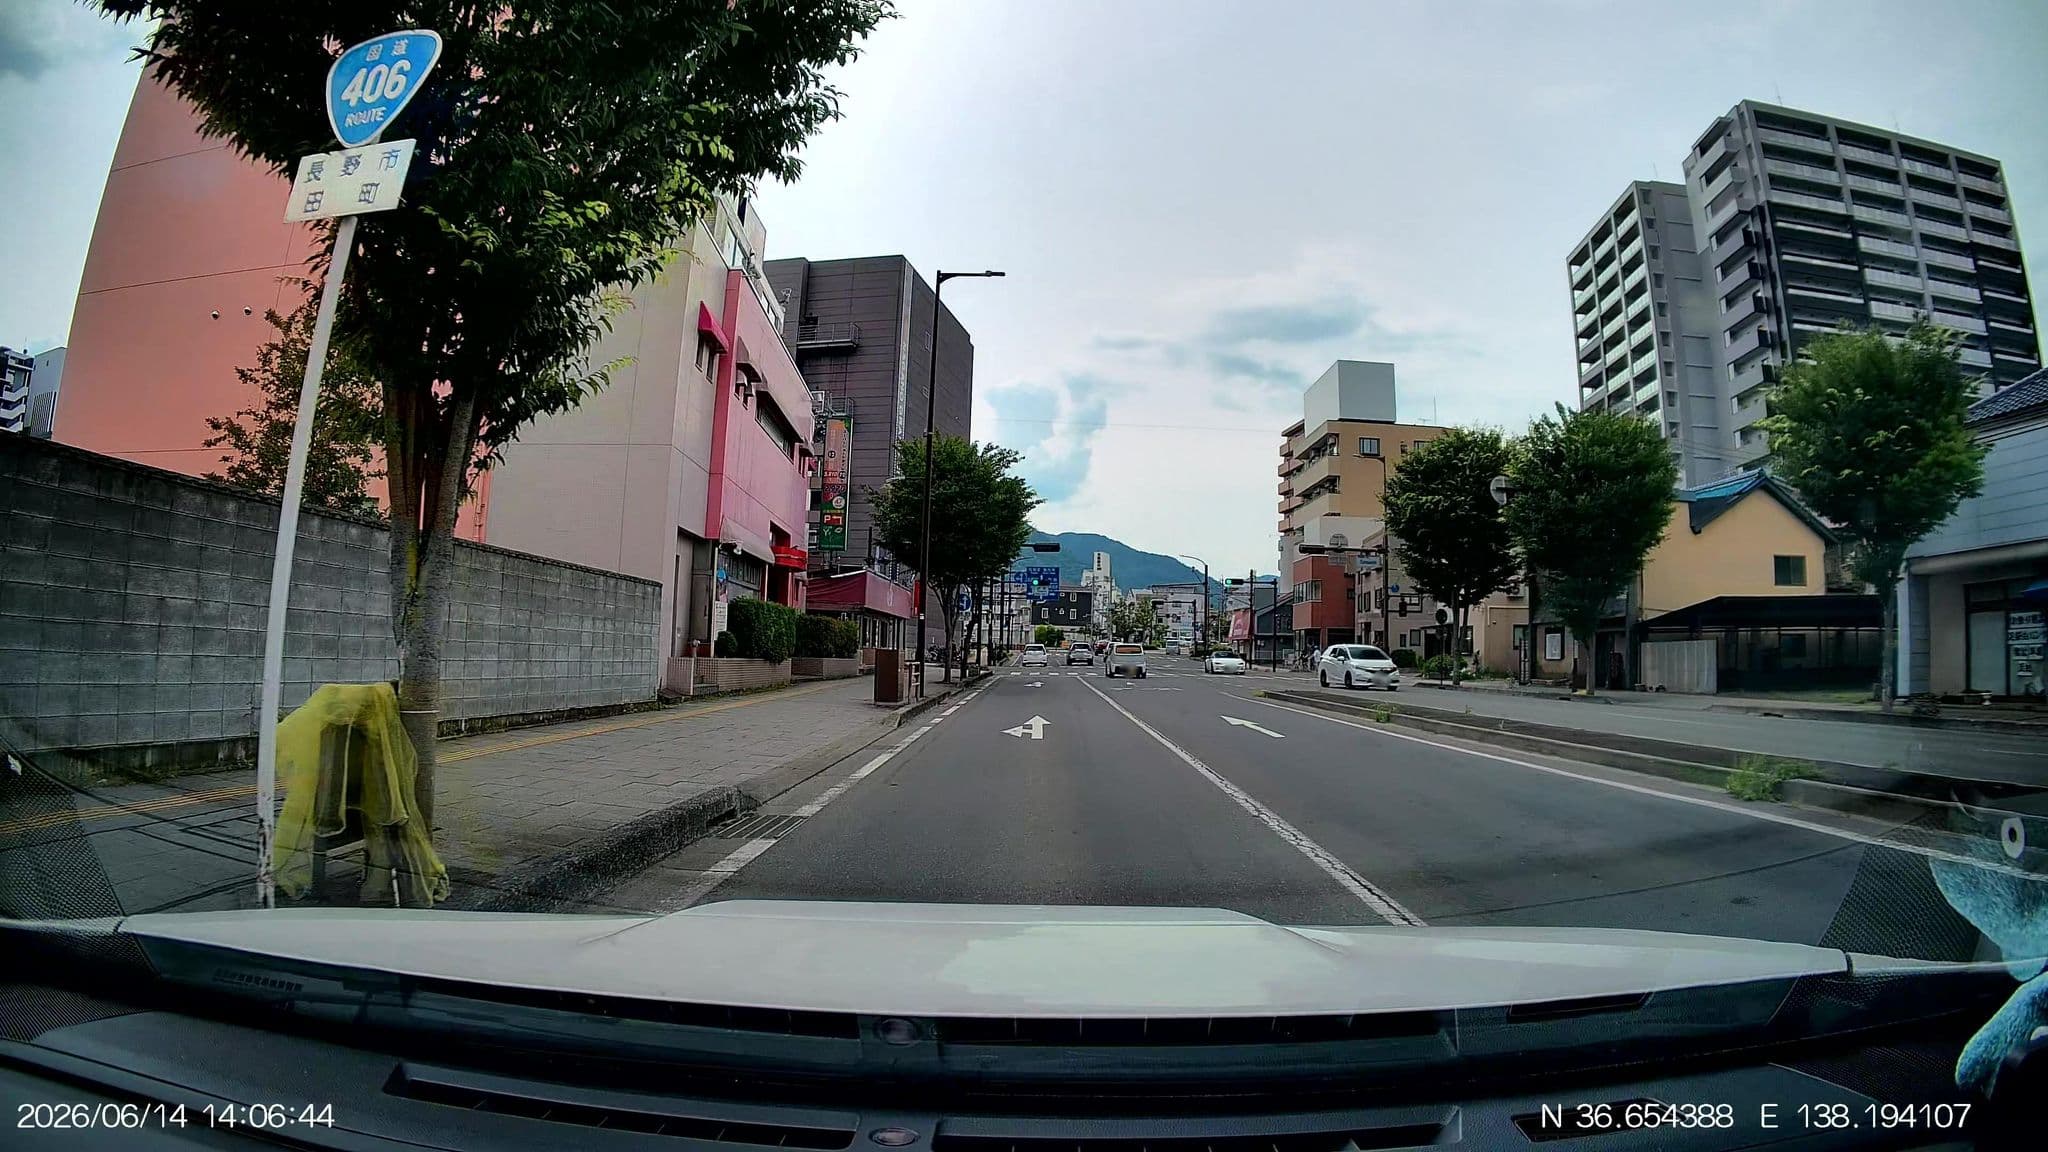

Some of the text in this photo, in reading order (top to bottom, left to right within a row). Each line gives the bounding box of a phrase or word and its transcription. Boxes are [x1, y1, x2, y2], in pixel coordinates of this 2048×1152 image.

[366, 39, 408, 61] 国道
[341, 59, 411, 107] 406
[345, 107, 386, 127] ROUTE
[305, 149, 402, 183] 長野市
[303, 182, 380, 213] 田町
